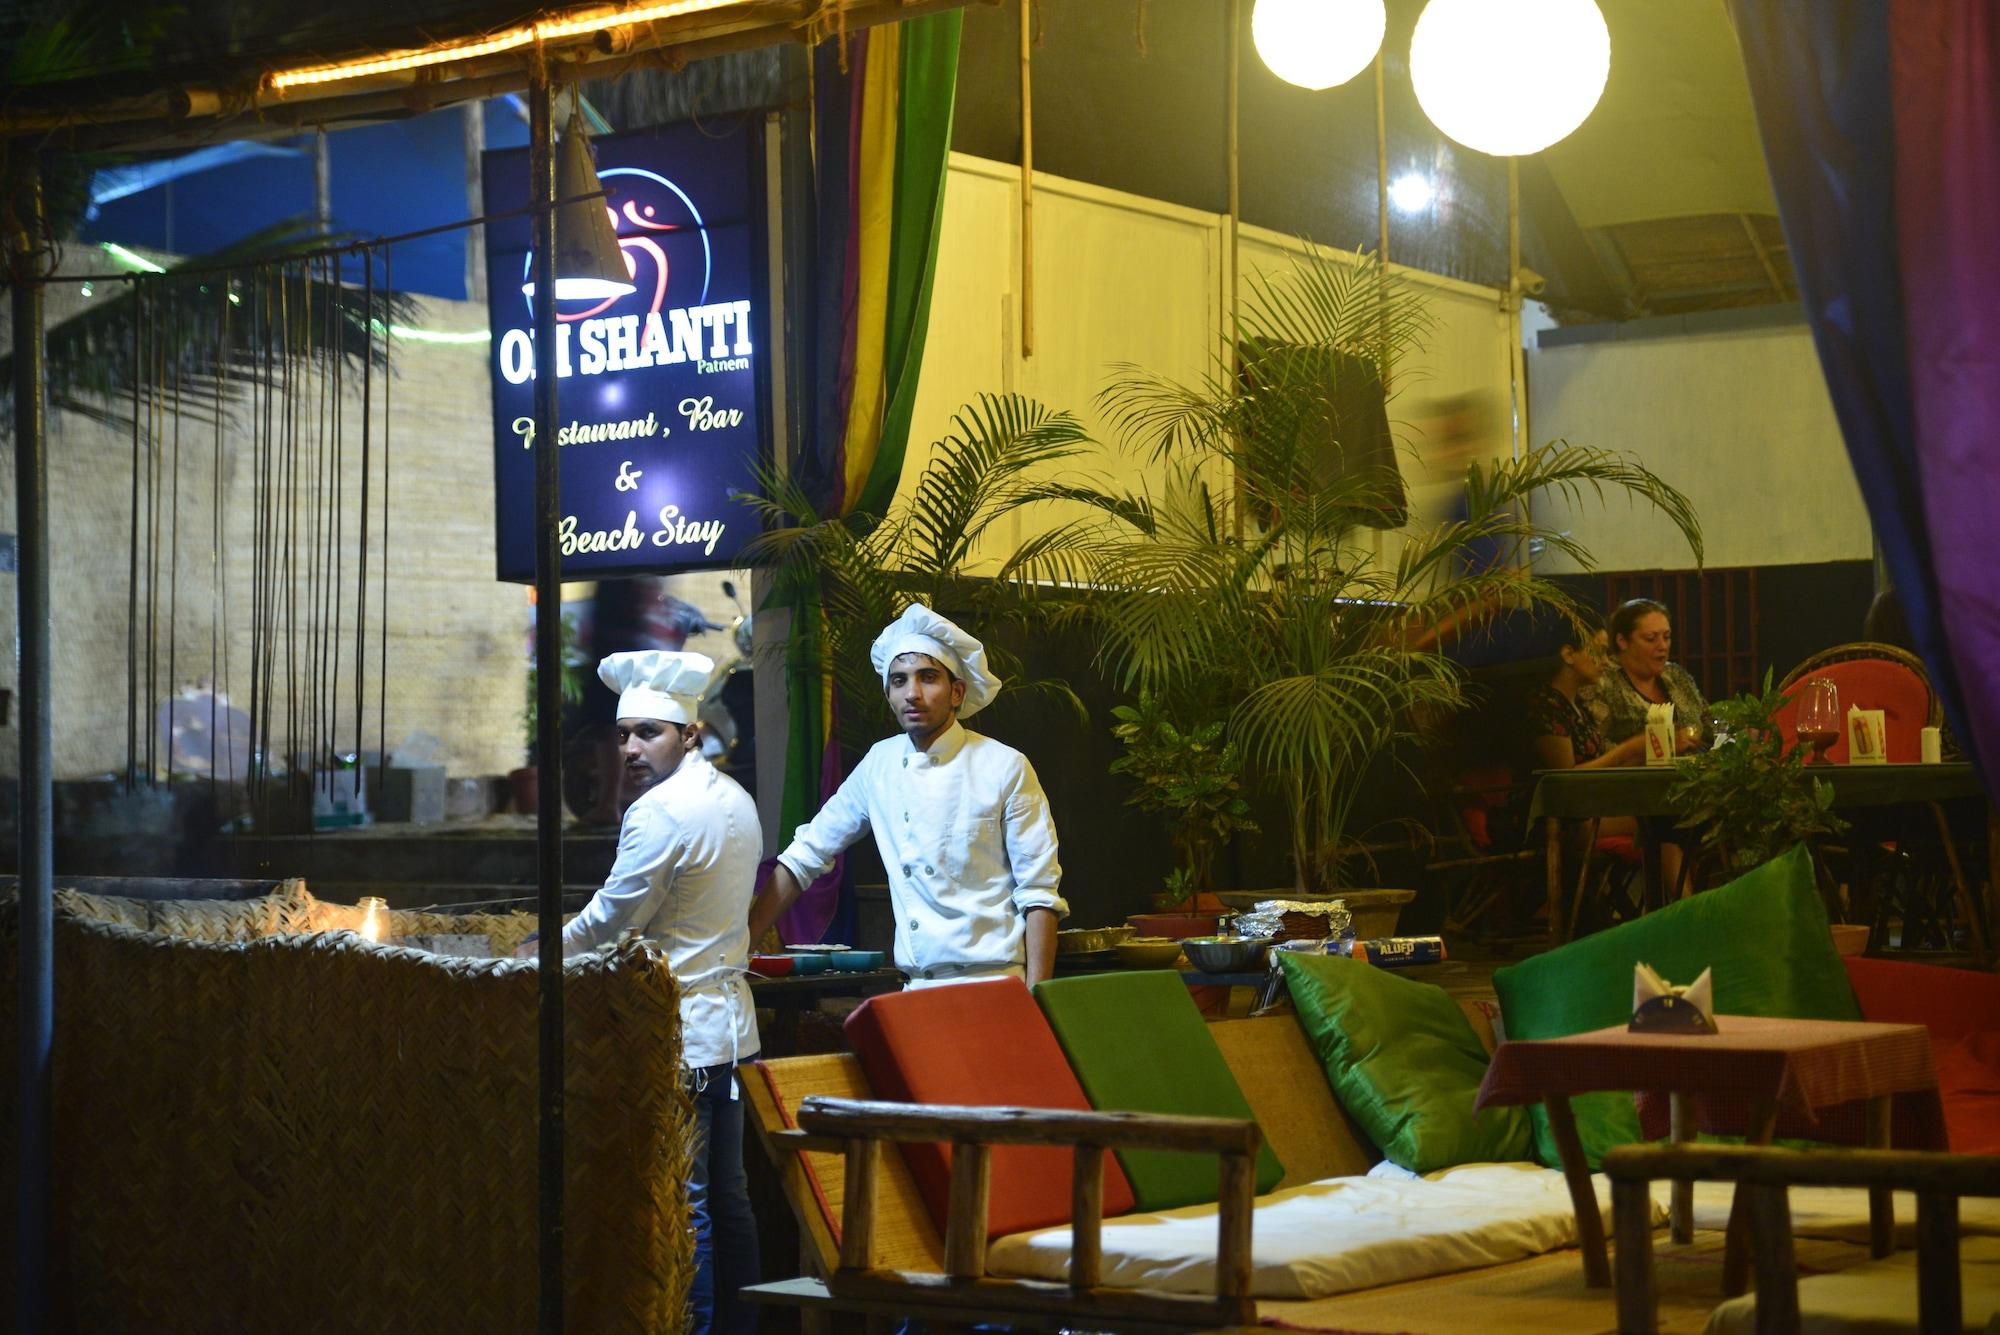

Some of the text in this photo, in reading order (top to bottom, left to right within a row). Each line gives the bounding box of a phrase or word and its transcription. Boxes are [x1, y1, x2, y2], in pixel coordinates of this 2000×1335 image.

[579, 299, 753, 375] SHANTI
[697, 357, 750, 375] Patnem
[677, 395, 744, 432] Bar
[614, 460, 643, 492] &
[558, 504, 726, 556] Beach Stay
